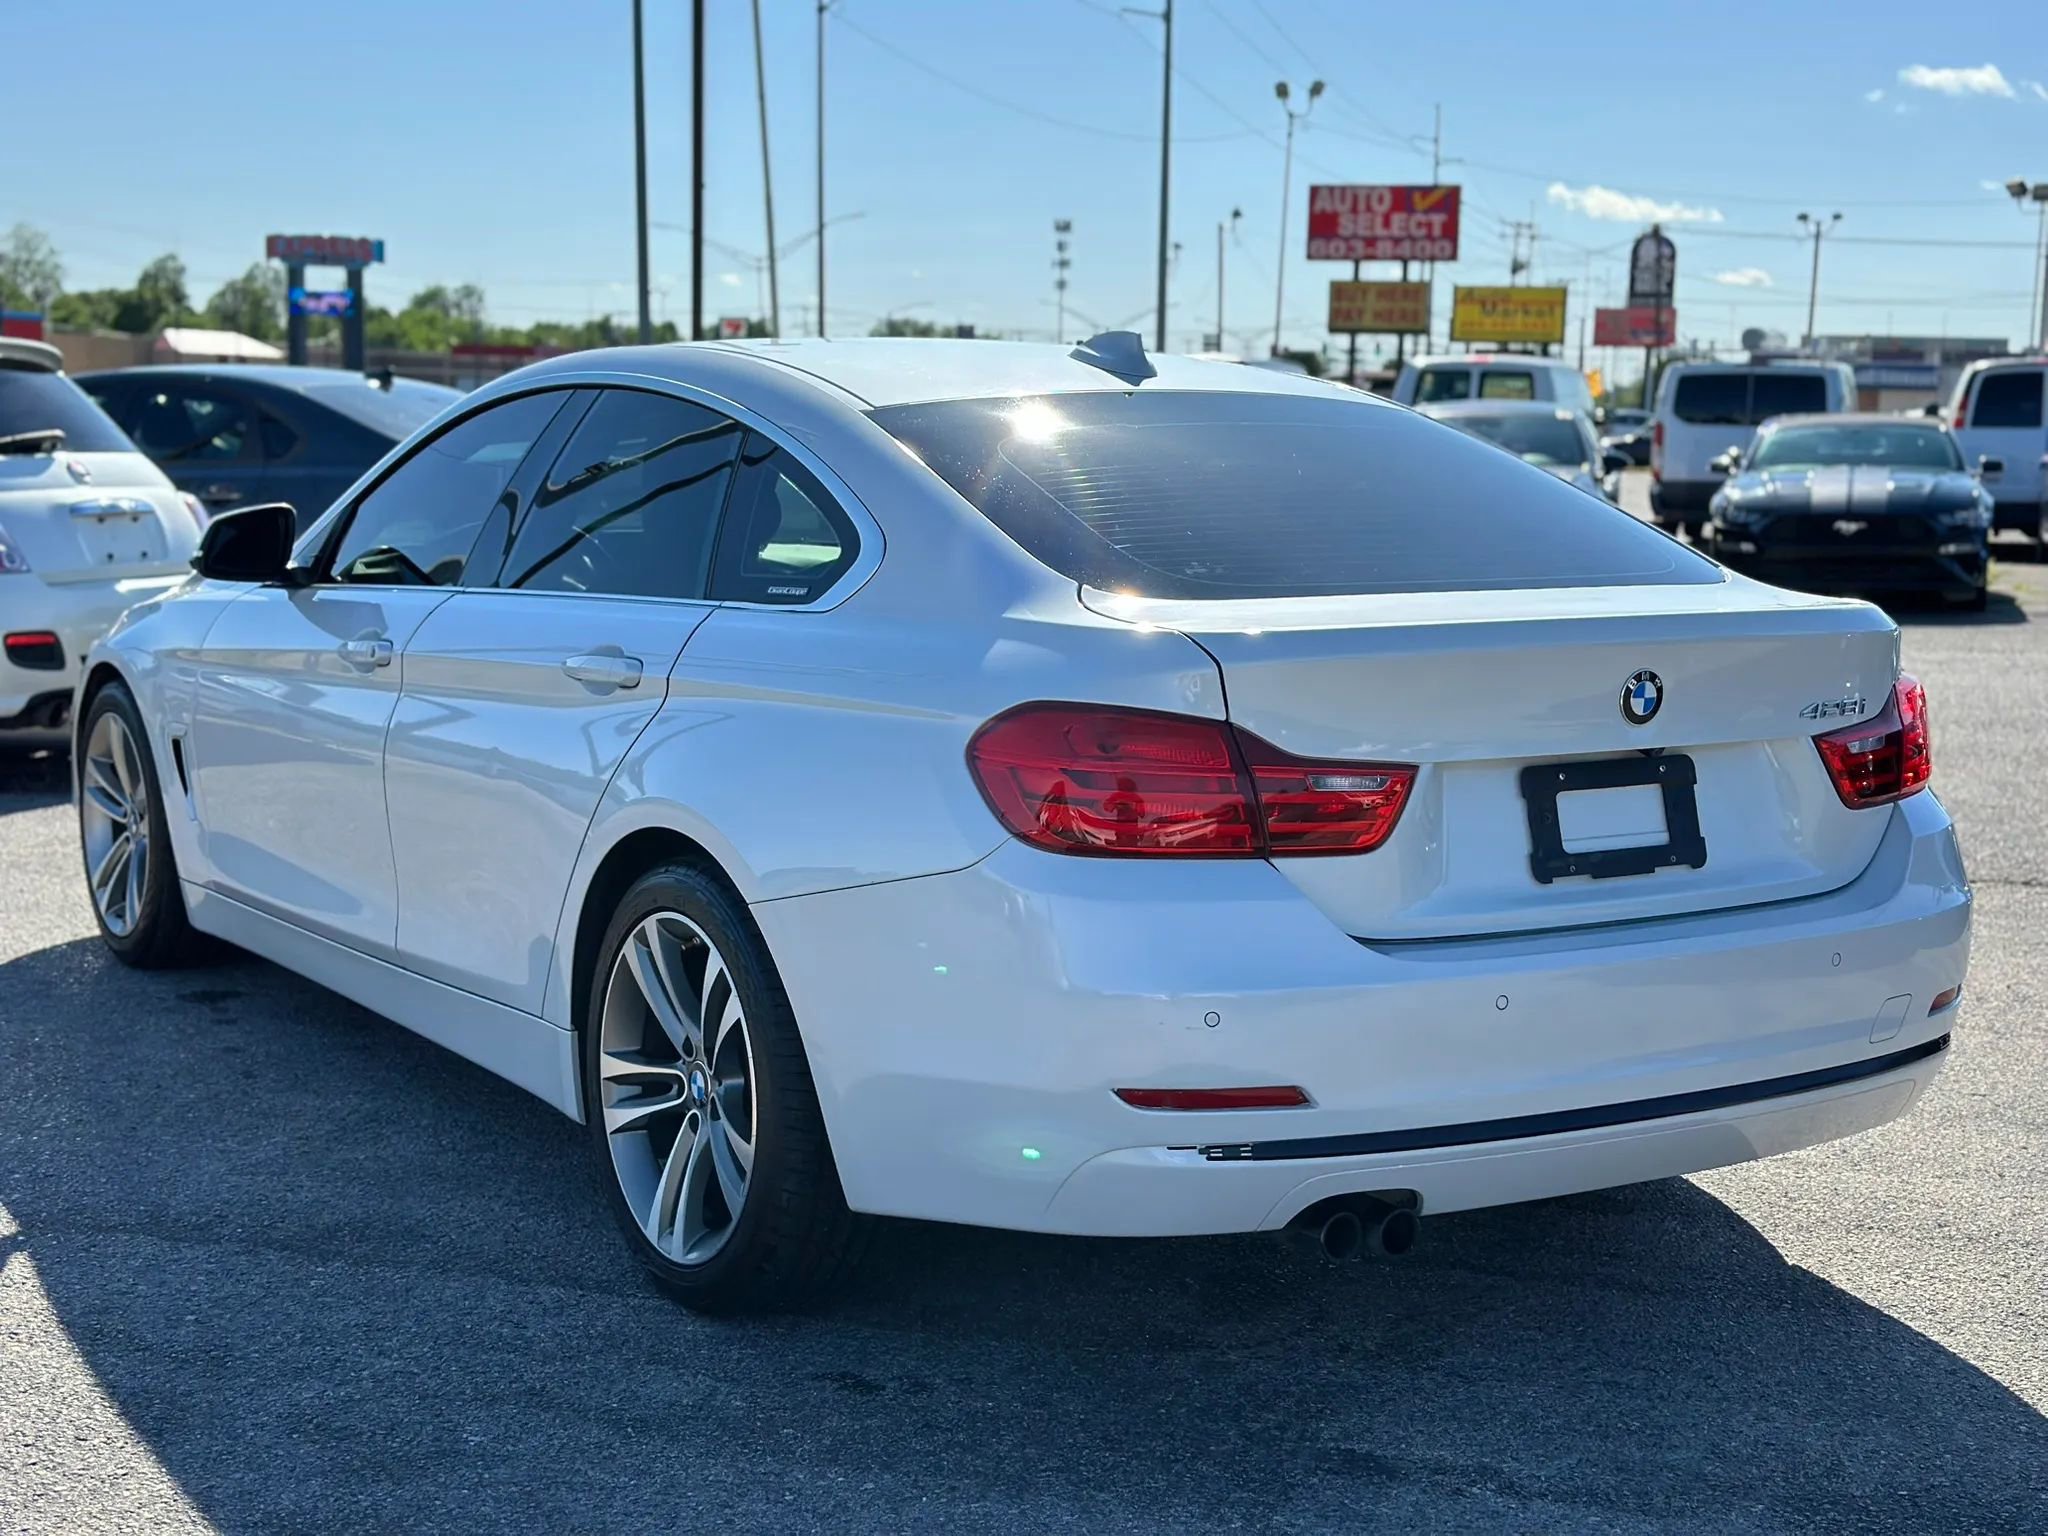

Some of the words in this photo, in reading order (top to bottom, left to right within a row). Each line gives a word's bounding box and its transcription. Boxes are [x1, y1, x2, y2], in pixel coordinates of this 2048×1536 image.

[1313, 187, 1393, 213] AUTO
[1337, 213, 1448, 238] SELECT
[1799, 698, 1866, 719] 428i
